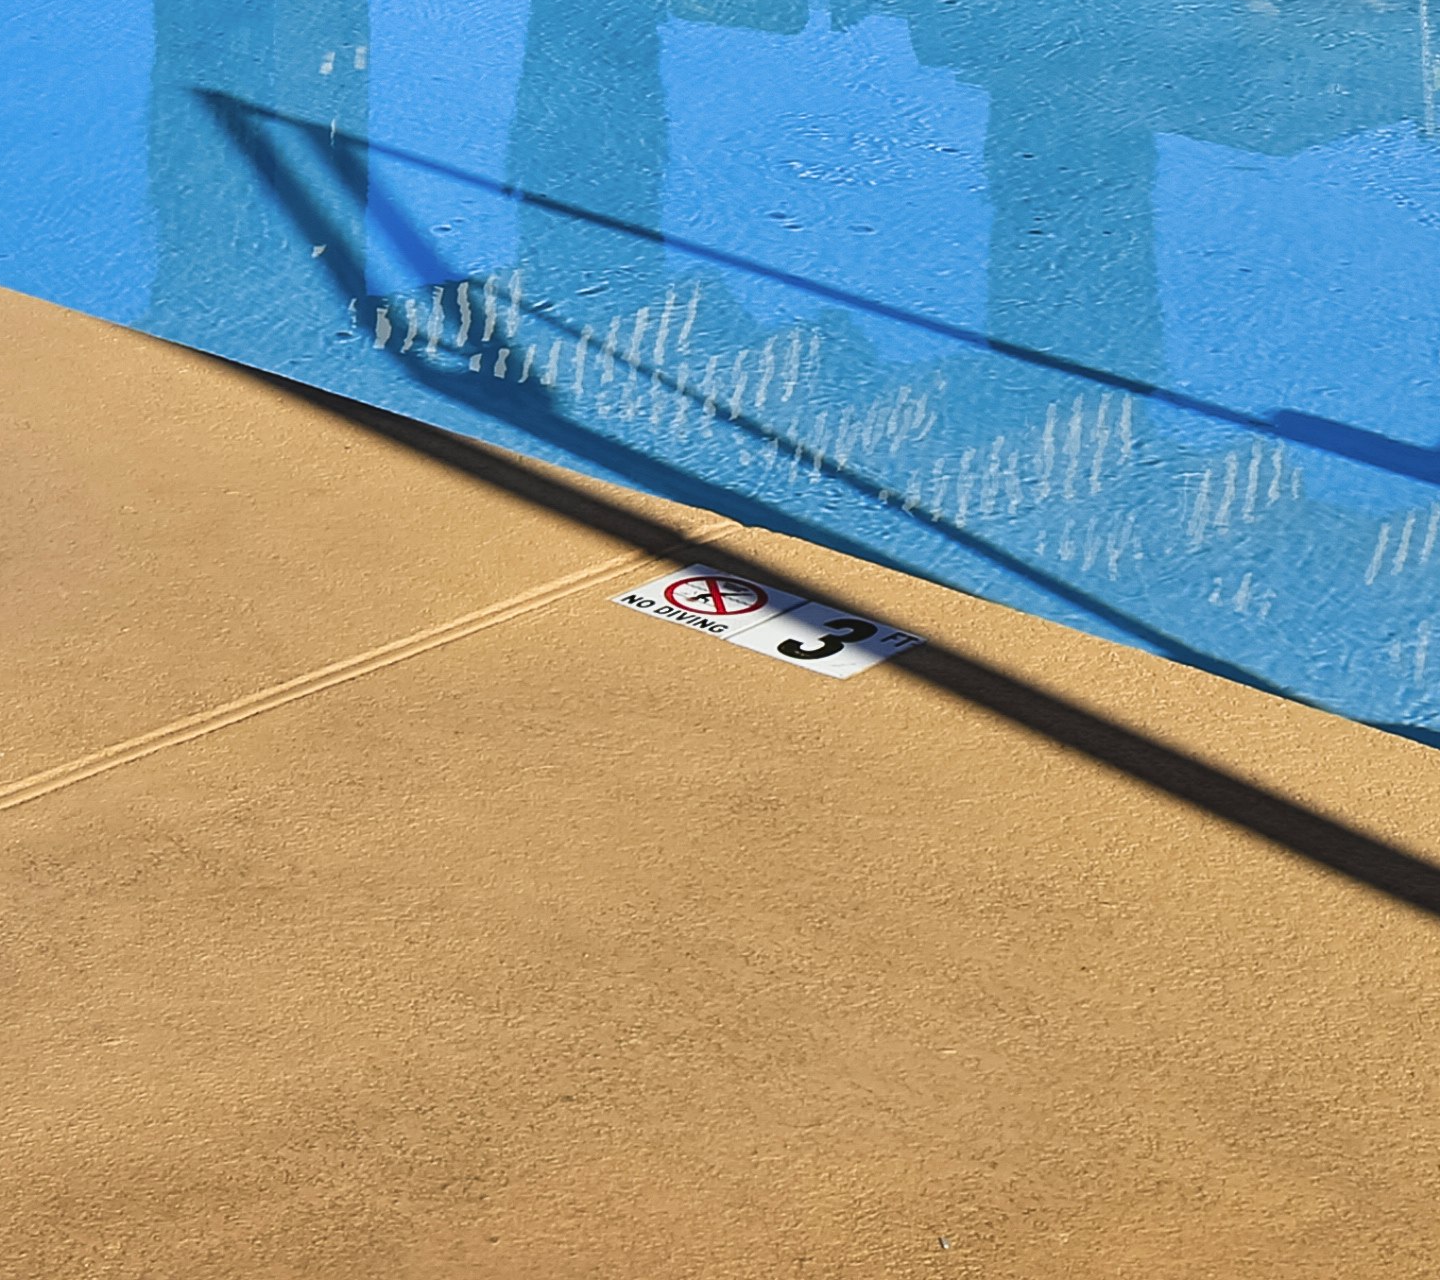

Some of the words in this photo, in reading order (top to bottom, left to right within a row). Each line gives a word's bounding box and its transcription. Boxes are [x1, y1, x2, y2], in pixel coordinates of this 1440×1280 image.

[621, 593, 656, 609] NO
[653, 605, 730, 635] DIVING
[776, 618, 879, 660] 3
